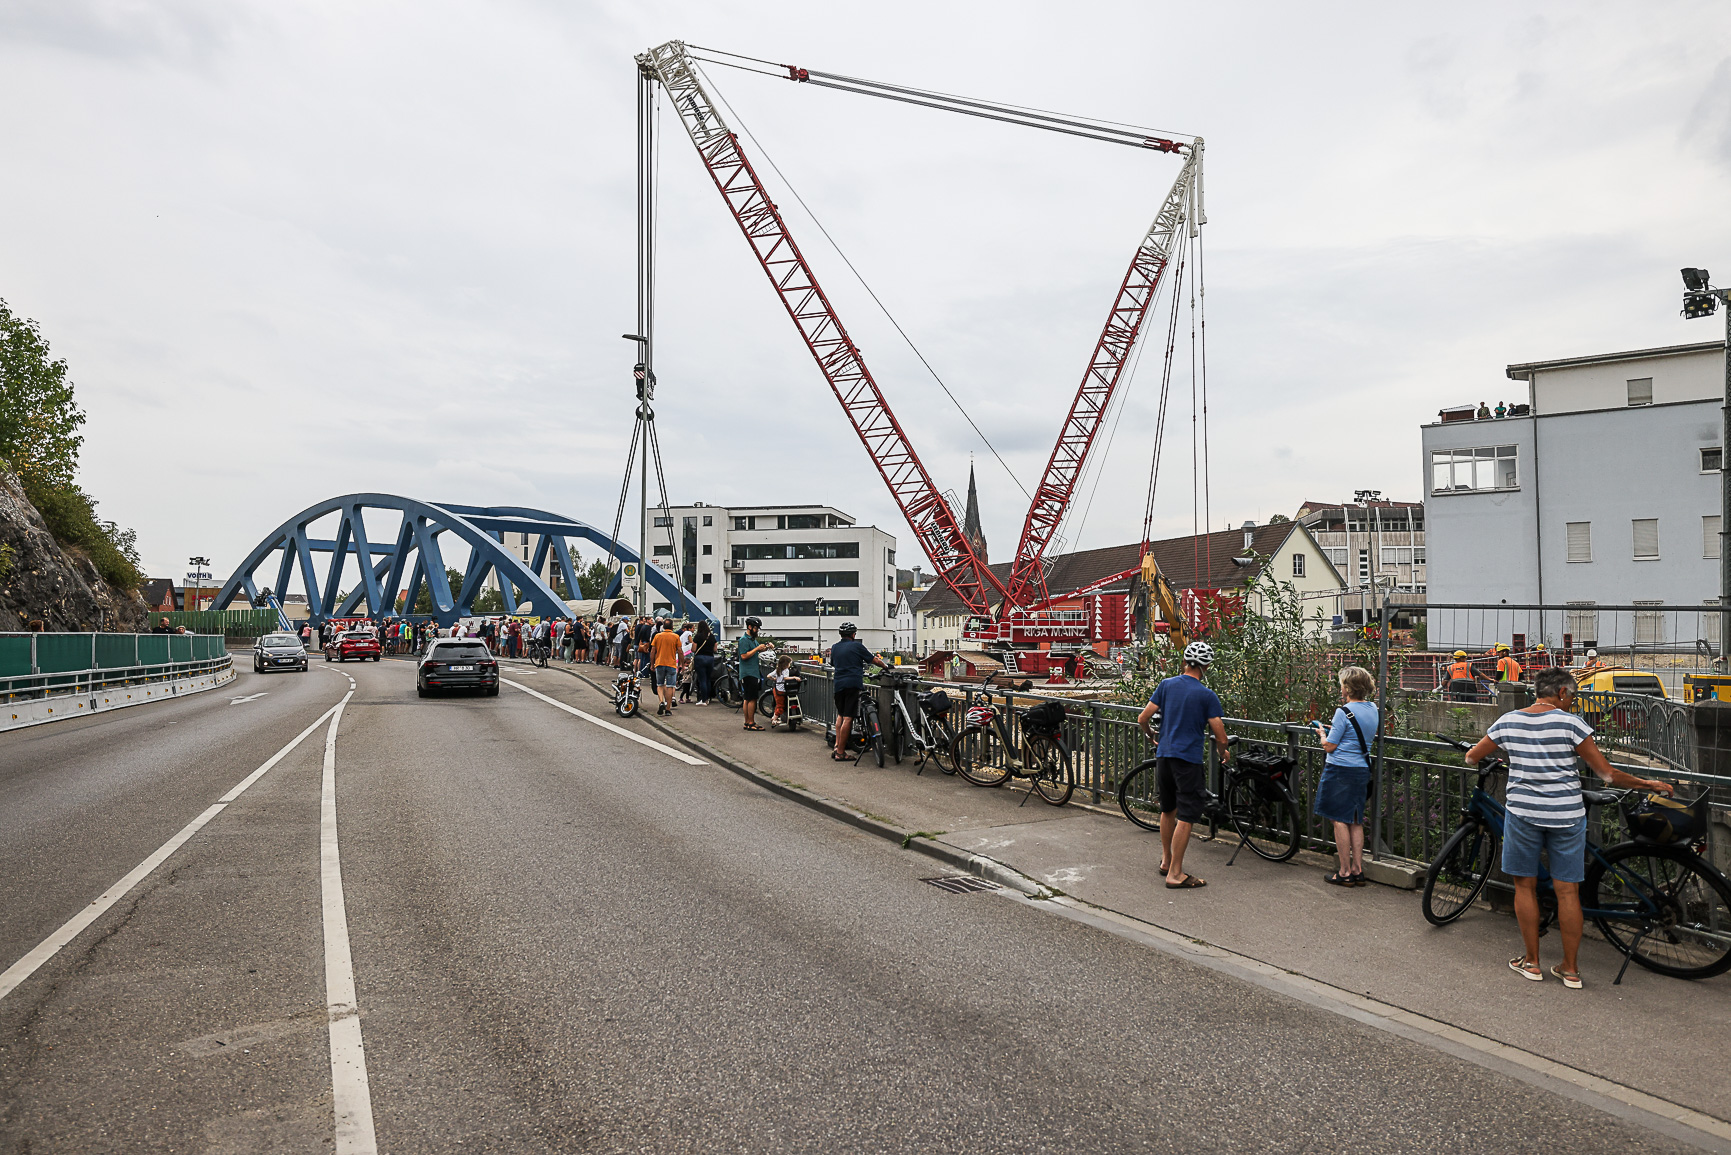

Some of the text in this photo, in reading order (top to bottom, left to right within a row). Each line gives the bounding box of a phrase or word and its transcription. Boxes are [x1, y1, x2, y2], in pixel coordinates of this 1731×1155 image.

[930, 522, 949, 551] LIEBHERR
[1024, 628, 1086, 637] RIGA MAINZ
